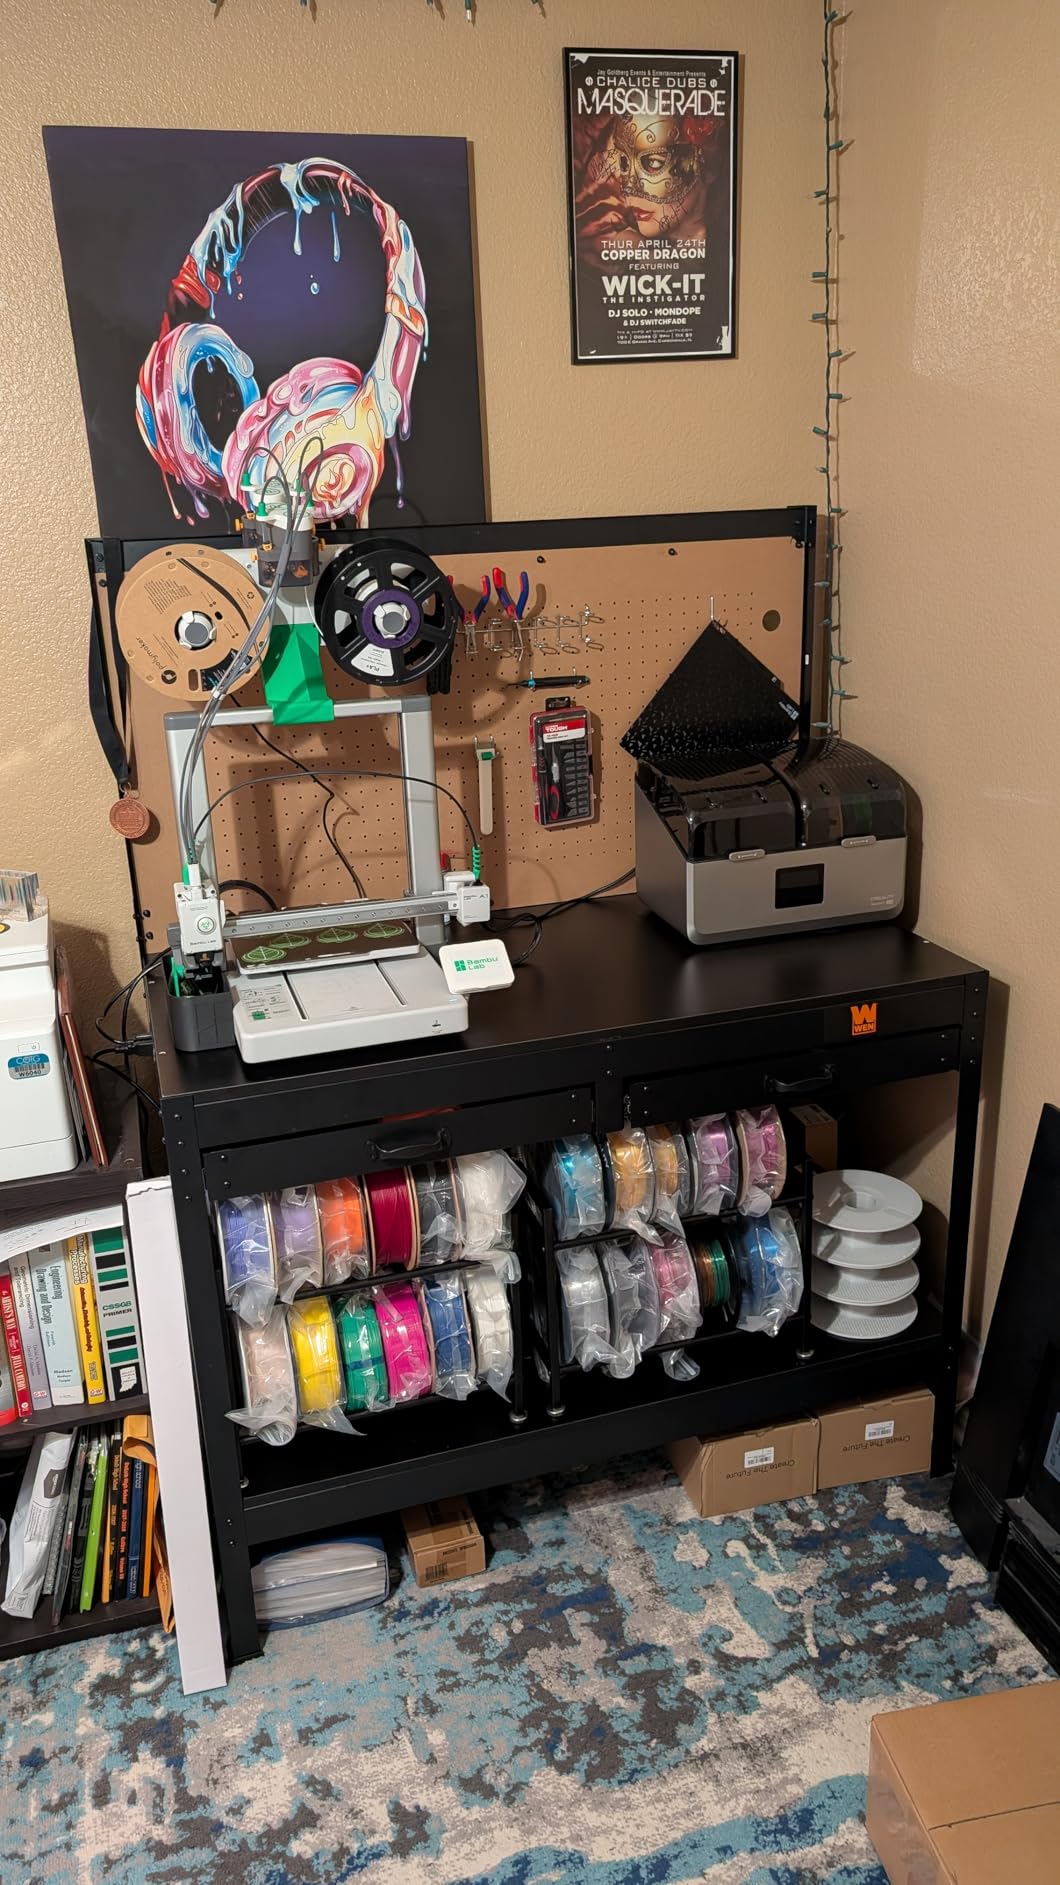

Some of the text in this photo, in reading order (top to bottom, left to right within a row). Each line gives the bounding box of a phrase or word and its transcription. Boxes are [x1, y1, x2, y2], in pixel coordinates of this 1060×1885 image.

[607, 69, 629, 77] Goldberg
[597, 76, 707, 88] CHALICE DUBS
[577, 88, 726, 116] MASQUERADE
[601, 239, 706, 249] THUR APRIL 24TH
[601, 248, 706, 260] COPPER DRAGON
[629, 262, 680, 270] FEATURING
[601, 273, 706, 296] WICK-IT
[631, 294, 706, 303] INSTIGATOR
[608, 307, 701, 317] DJ SOLO MONDOPE
[640, 318, 687, 326] SWITCHFADE
[136, 637, 166, 671] polymaker
[467, 957, 499, 965] Bambu
[854, 1023, 874, 1033] WEN
[75, 1234, 88, 1284] Manufacturing
[70, 1250, 80, 1285] Processes
[49, 1265, 64, 1300] Engineering
[36, 1268, 53, 1324] Drawing and Design
[102, 1301, 132, 1311] CSSGB
[103, 1309, 132, 1317] PRIMER
[842, 1443, 868, 1452] Future
[726, 1459, 796, 1479] Create The Future
